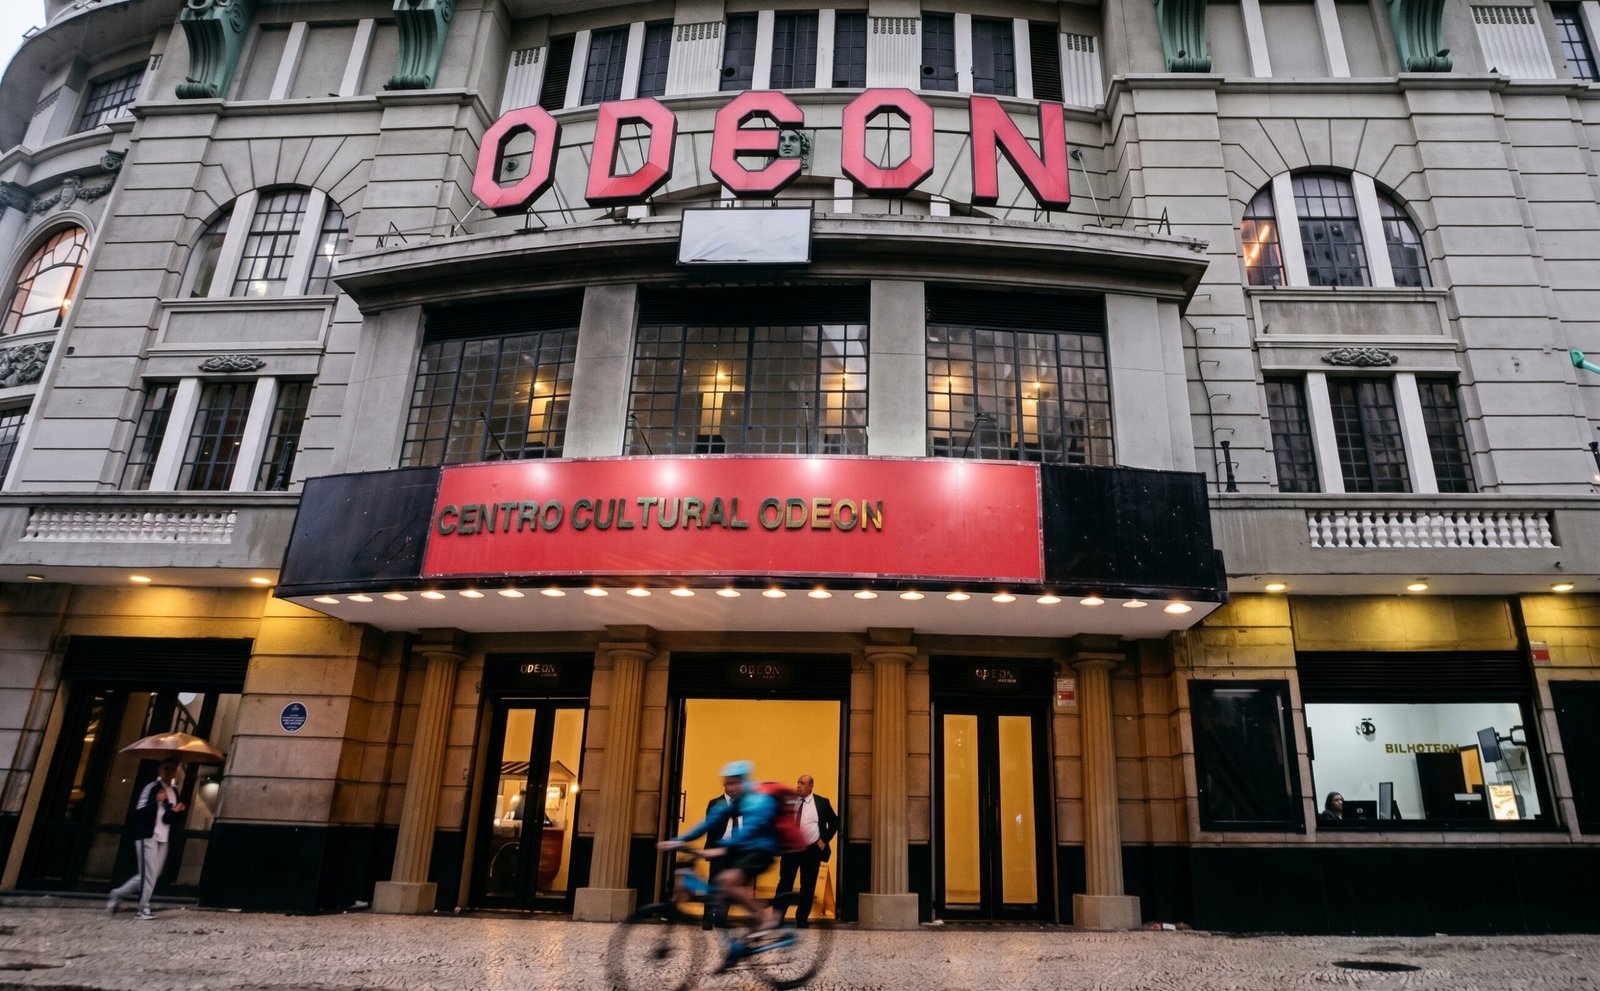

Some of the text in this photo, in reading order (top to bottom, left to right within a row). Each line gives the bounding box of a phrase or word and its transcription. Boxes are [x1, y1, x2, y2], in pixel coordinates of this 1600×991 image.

[471, 87, 1072, 213] ODEON
[437, 496, 884, 536] CENTRO CULTURAL ODEON
[520, 664, 557, 674] ODEON
[975, 669, 1015, 680] ODEON
